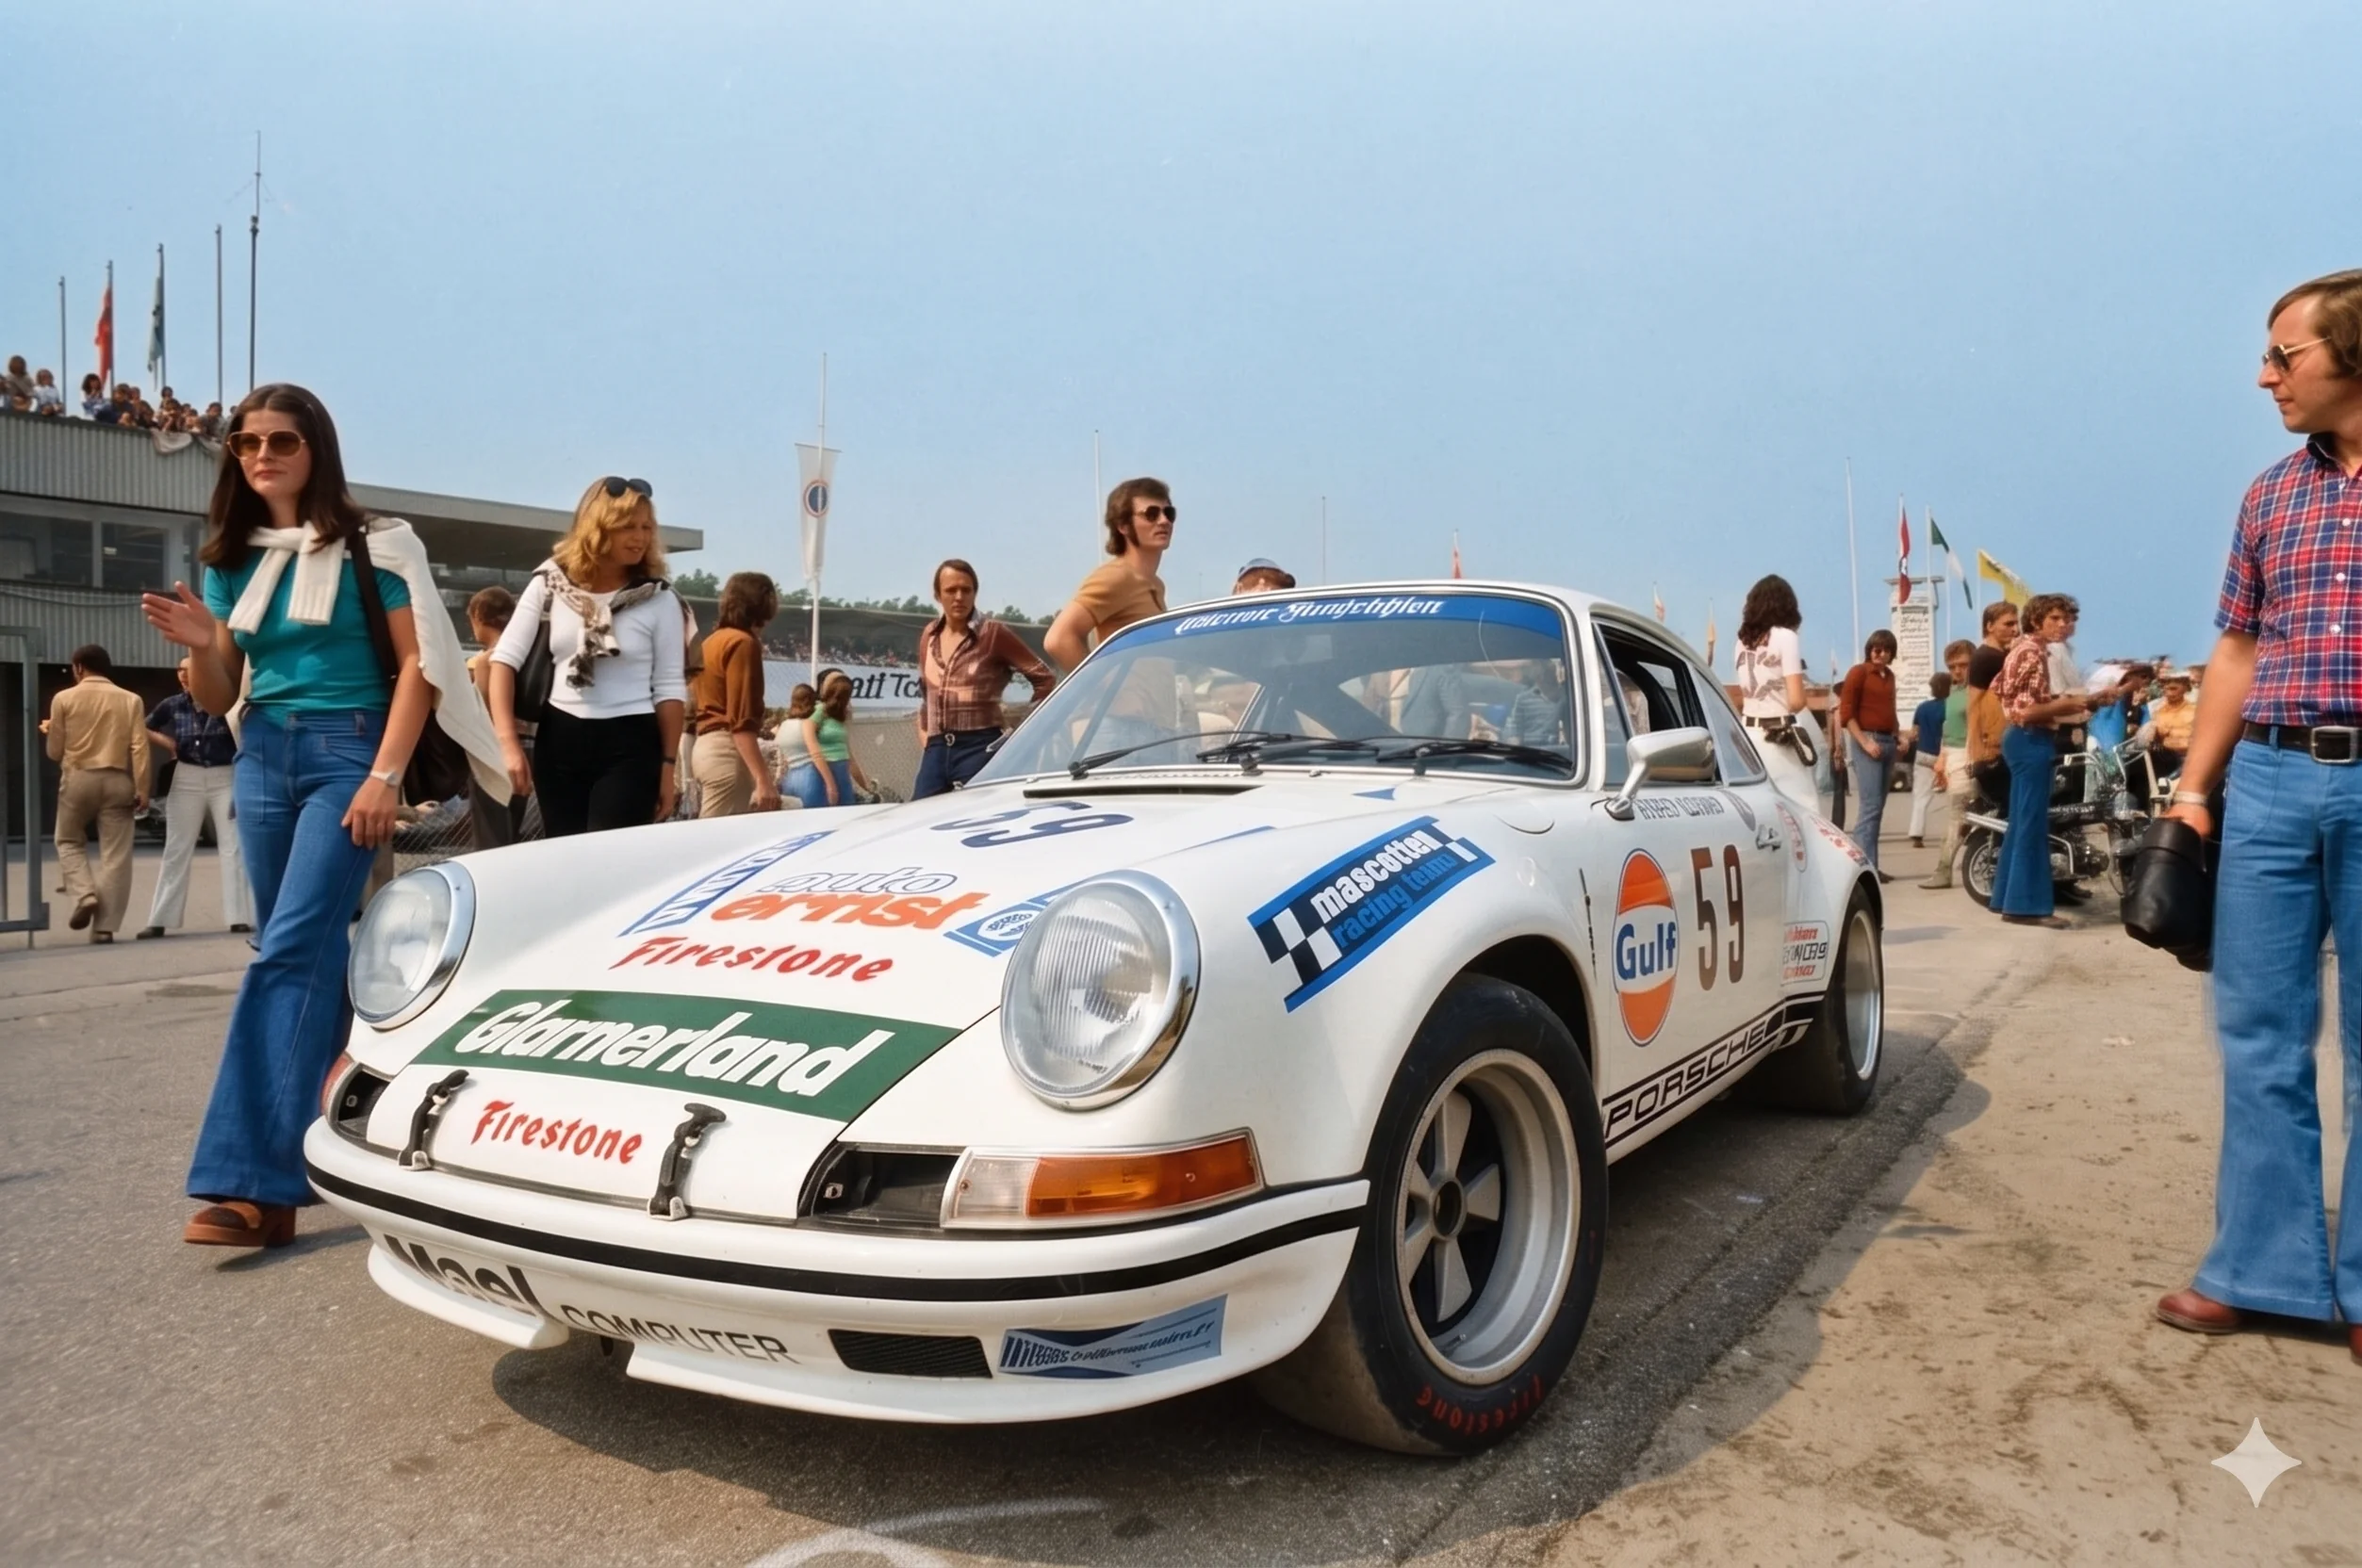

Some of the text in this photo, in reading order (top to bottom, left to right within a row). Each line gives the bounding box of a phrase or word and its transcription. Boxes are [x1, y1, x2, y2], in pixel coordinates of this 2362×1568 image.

[749, 867, 959, 894] auto
[1331, 884, 1414, 948] racing
[1691, 844, 1745, 990] 59
[607, 937, 894, 982] Firestone
[1616, 923, 1677, 981] Gulf
[454, 999, 895, 1096] Glarnerland
[1605, 1020, 1768, 1138] PORSCHE
[471, 1101, 643, 1164] Firestone
[559, 1304, 801, 1364] COMPUTER
